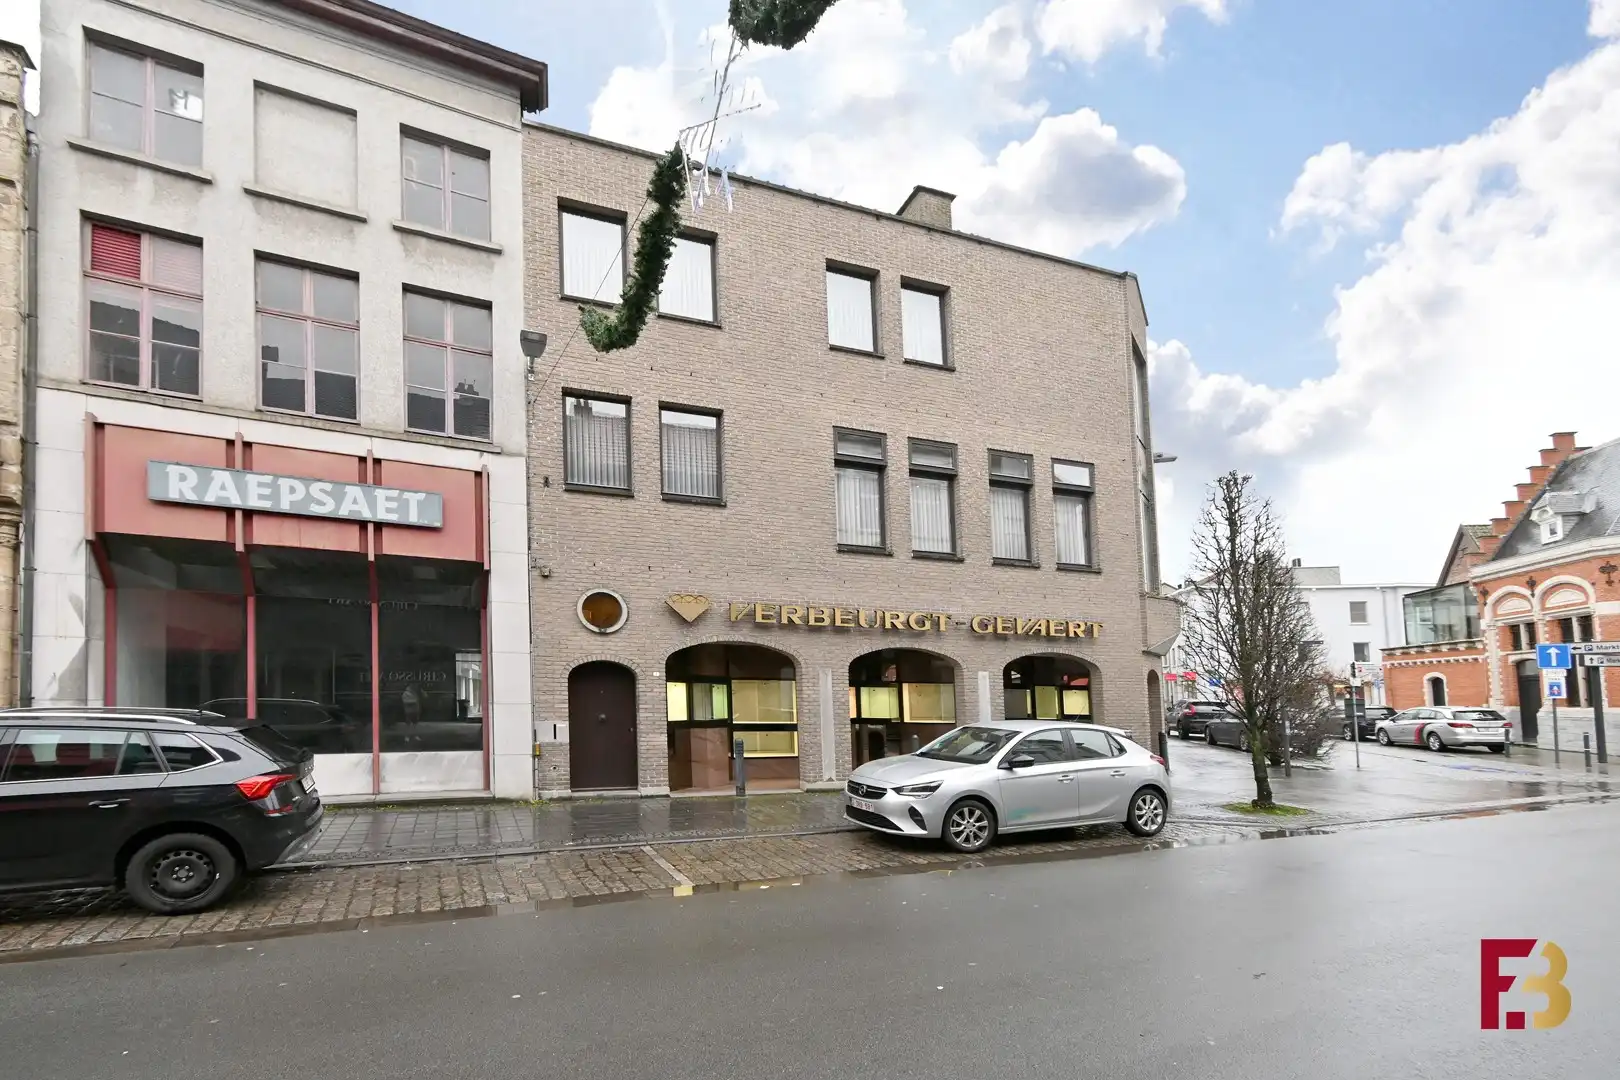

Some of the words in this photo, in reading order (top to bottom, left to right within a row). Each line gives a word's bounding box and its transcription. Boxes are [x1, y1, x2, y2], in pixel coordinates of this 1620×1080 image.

[165, 464, 426, 523] RAEPSAET
[730, 602, 952, 631] VERBEURGT
[971, 615, 1104, 638] GEVAERT
